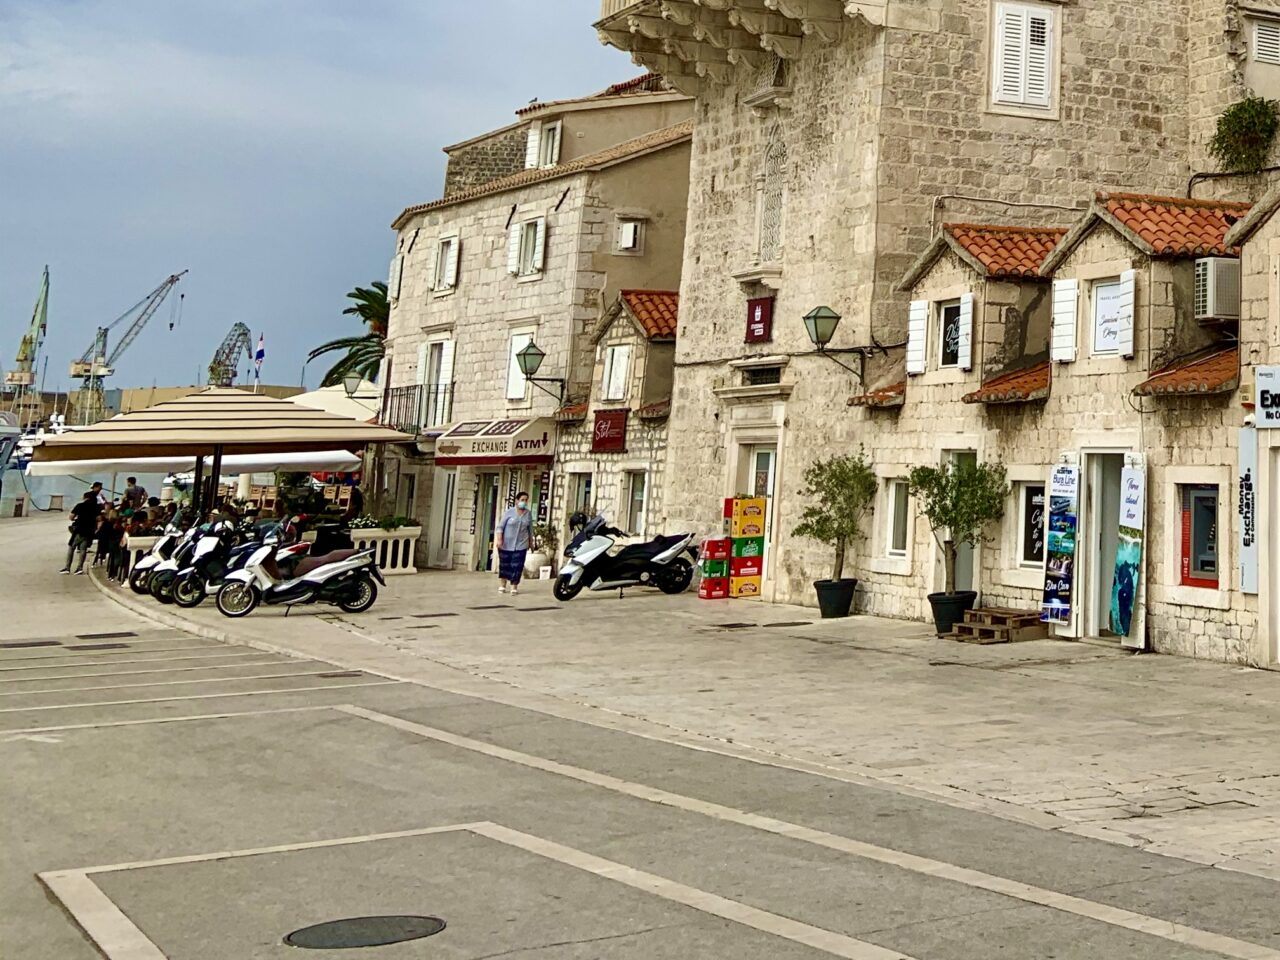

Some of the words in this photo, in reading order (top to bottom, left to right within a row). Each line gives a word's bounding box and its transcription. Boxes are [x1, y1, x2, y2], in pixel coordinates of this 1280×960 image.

[1265, 411, 1275, 420] No
[471, 441, 508, 453] EXCHANGE
[515, 439, 541, 449] ATM
